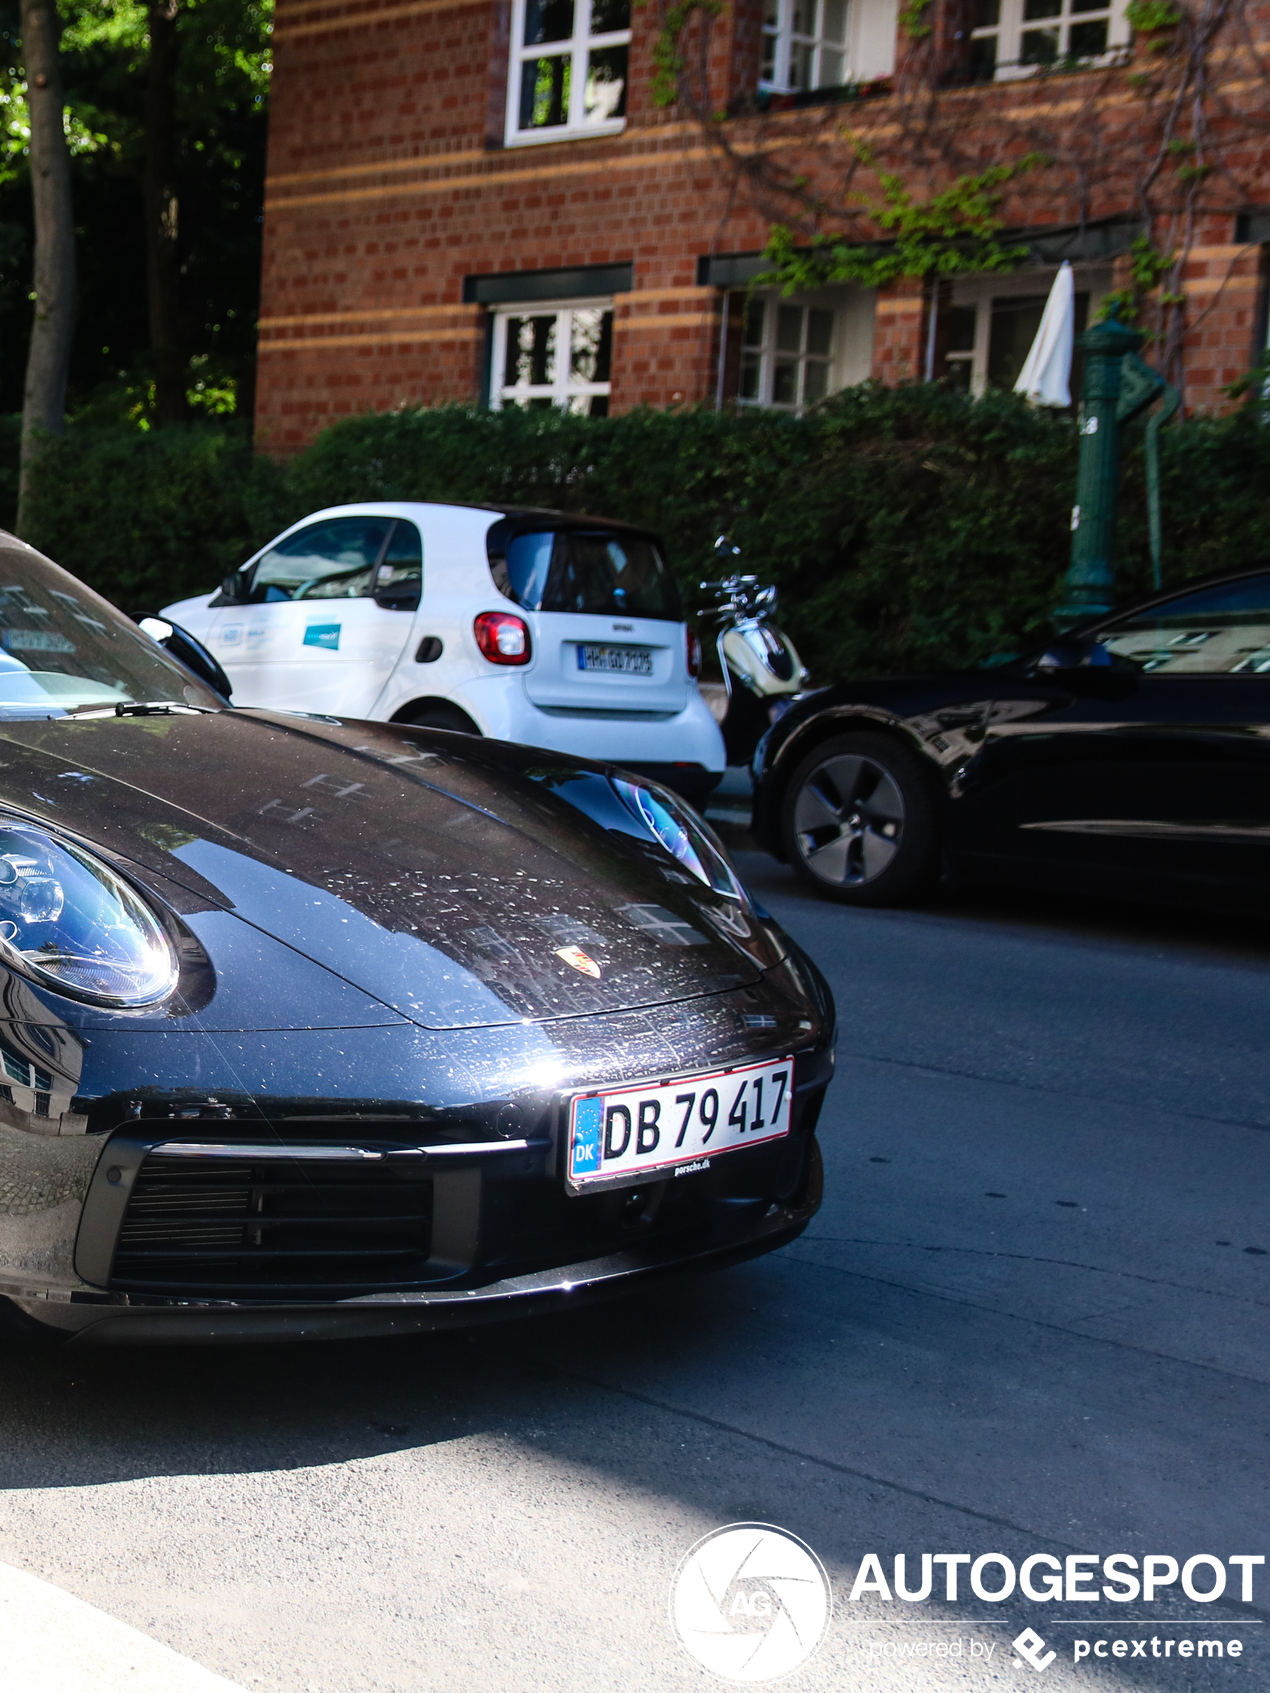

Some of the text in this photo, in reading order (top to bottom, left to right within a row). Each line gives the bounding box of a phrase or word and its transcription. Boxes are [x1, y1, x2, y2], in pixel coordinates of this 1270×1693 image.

[603, 1070, 788, 1160] DB 79 417
[576, 1143, 594, 1162] DK
[674, 1158, 711, 1177] porsche.dk
